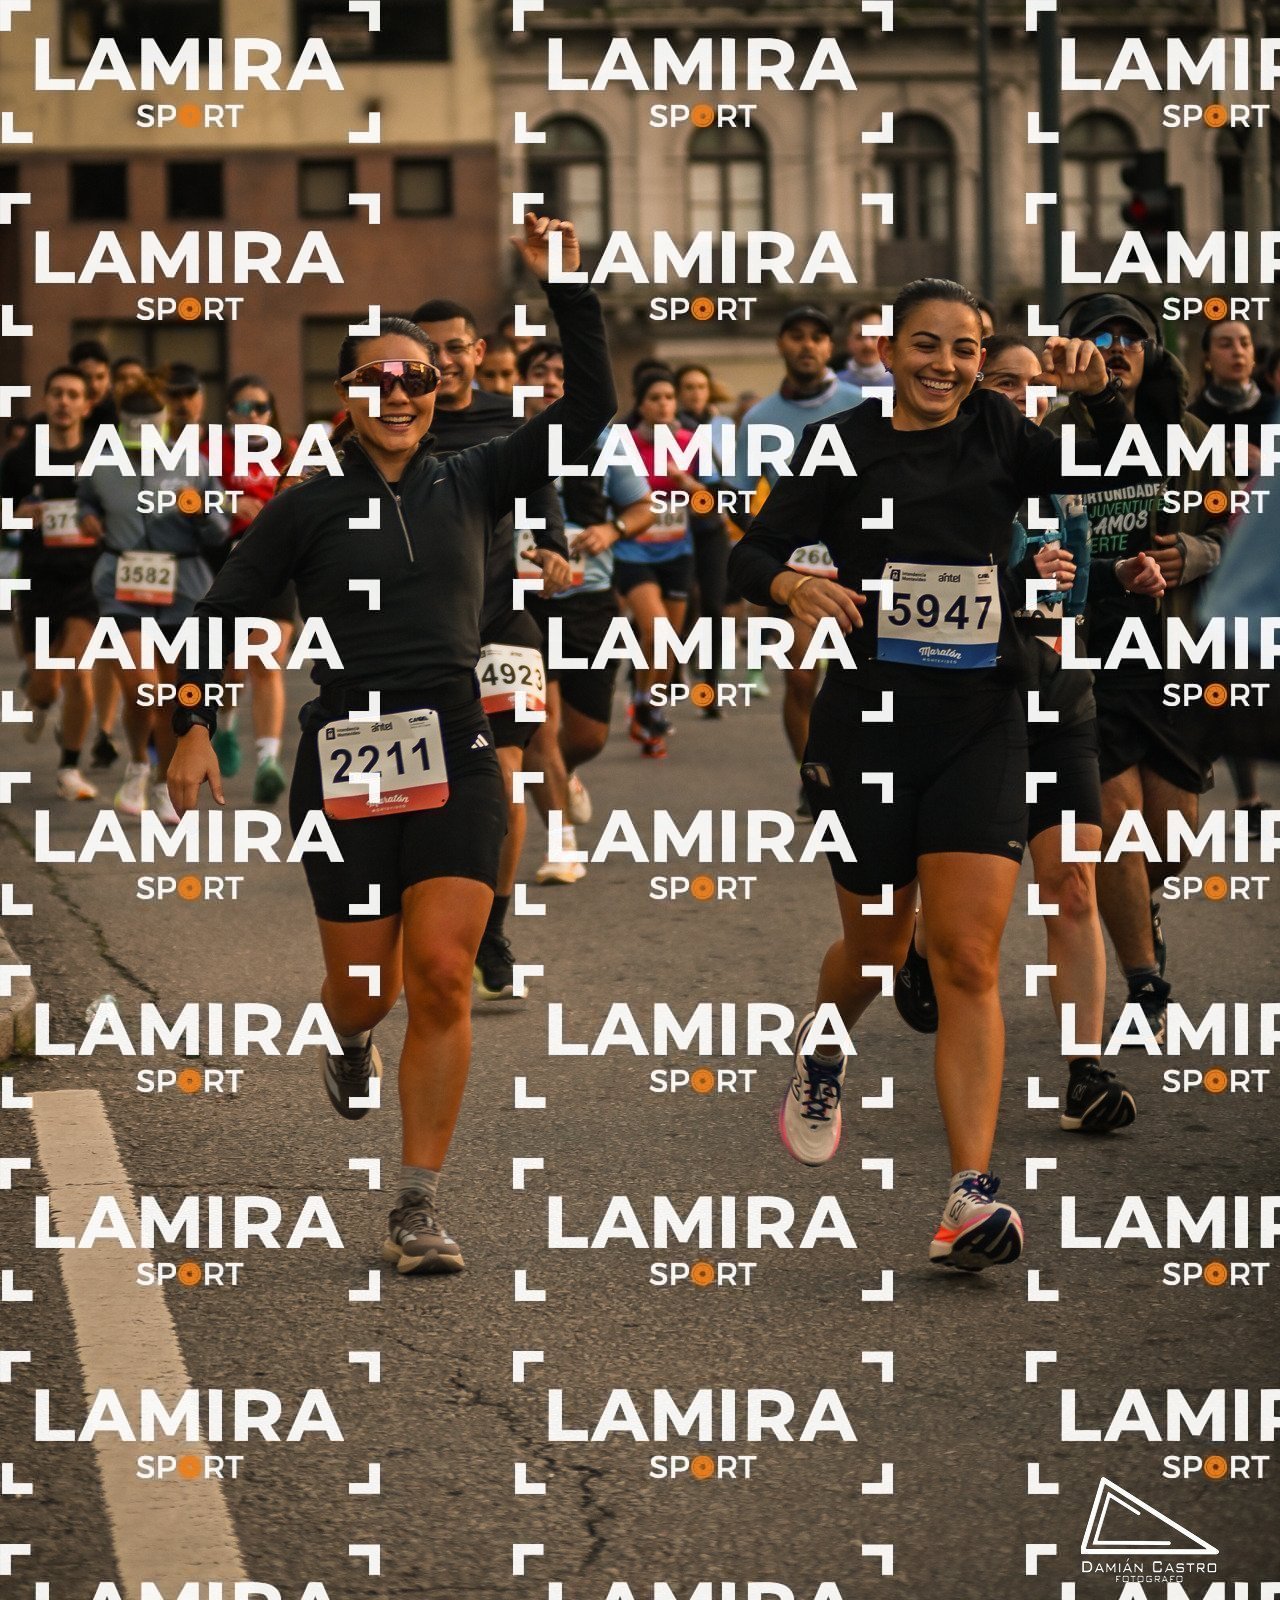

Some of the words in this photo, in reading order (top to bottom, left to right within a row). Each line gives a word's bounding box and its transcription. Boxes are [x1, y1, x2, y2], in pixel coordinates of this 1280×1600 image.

[120, 565, 170, 585] 3582
[888, 592, 993, 630] 5947
[482, 662, 543, 691] 4923
[330, 737, 430, 784] 2211
